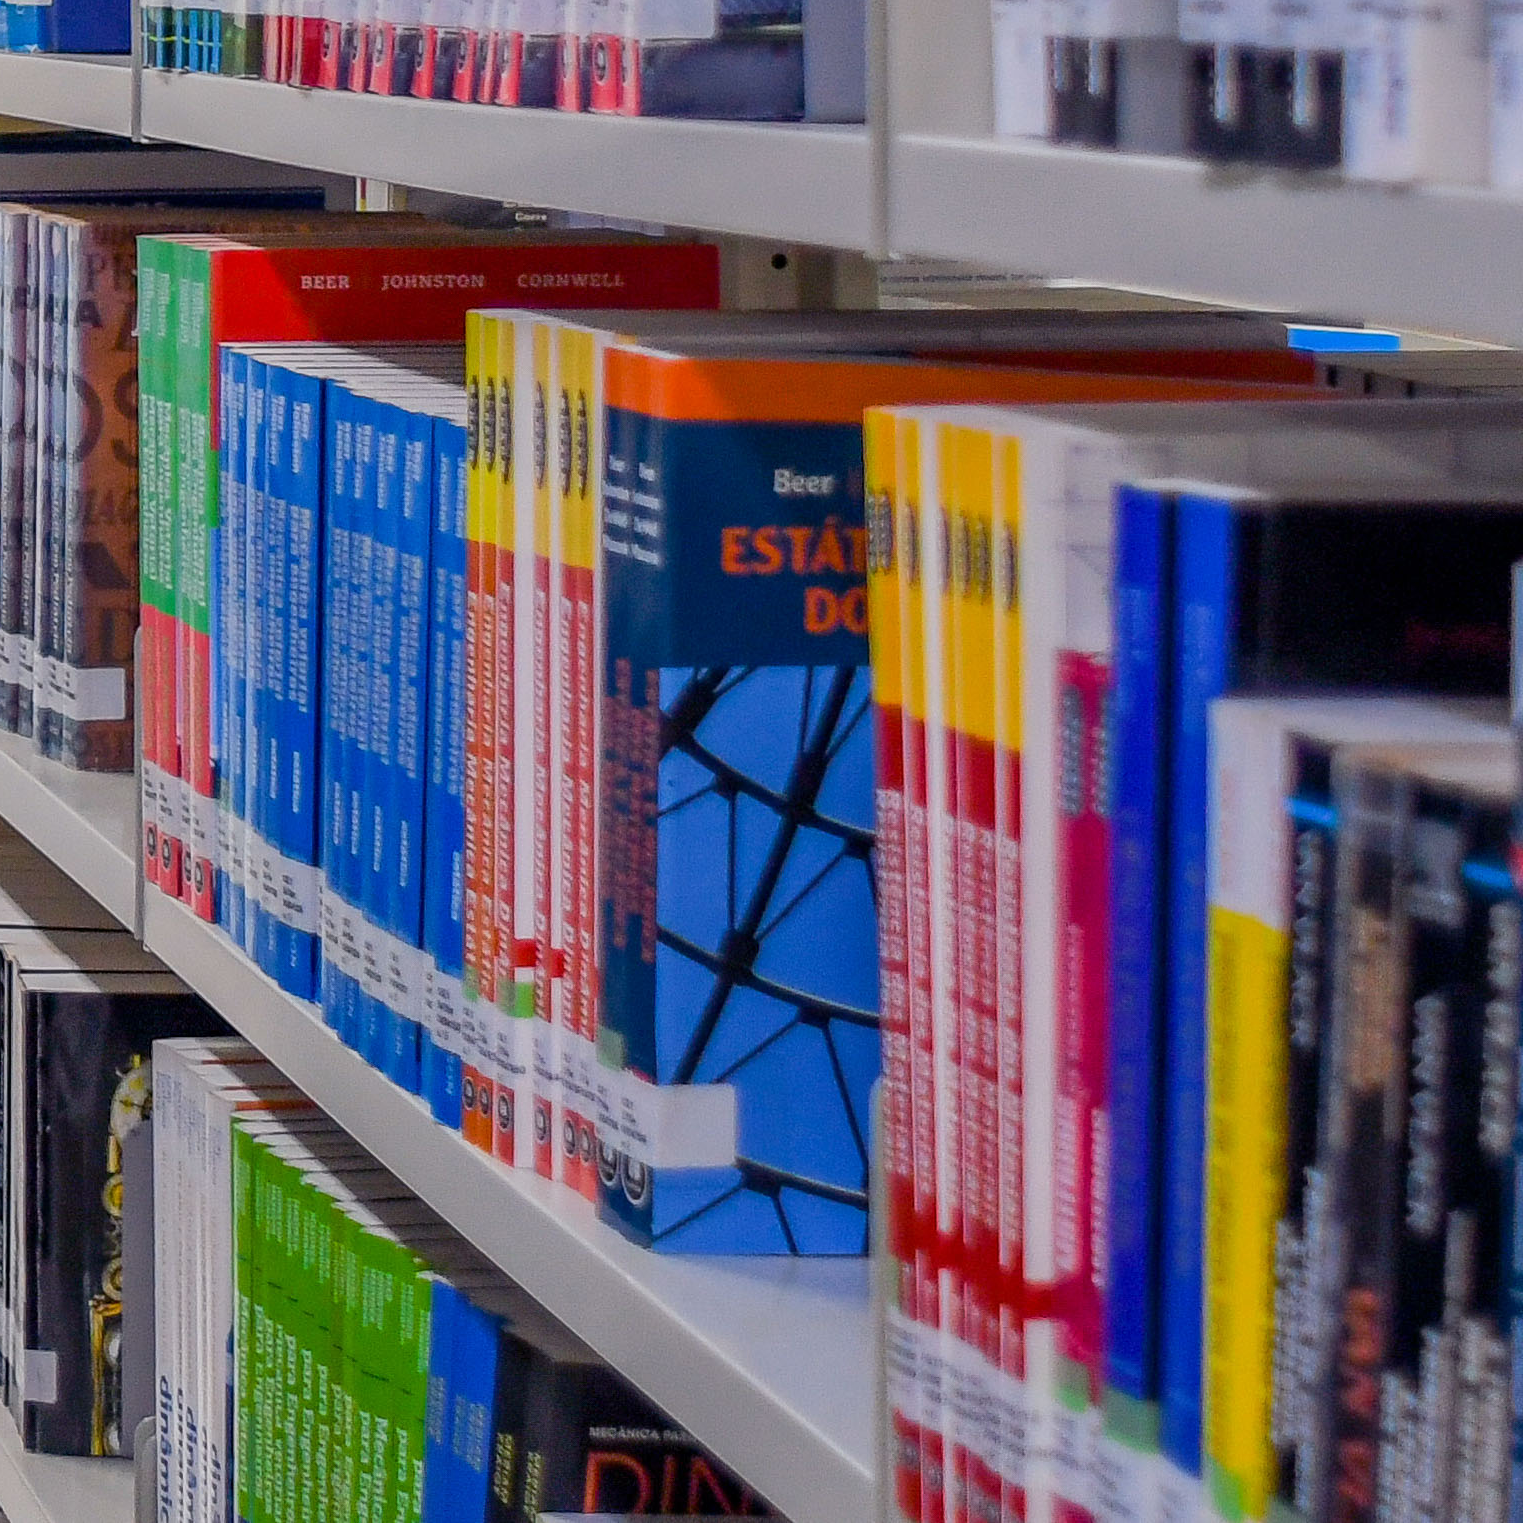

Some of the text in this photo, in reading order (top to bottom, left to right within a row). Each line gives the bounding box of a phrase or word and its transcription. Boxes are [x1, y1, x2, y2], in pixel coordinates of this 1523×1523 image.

[300, 274, 351, 291] BEER
[381, 273, 486, 291] JOHNSTON
[517, 273, 626, 288] CORNWELL
[773, 467, 835, 495] Beer
[721, 514, 868, 576] ESTÁT
[804, 584, 868, 636] DO
